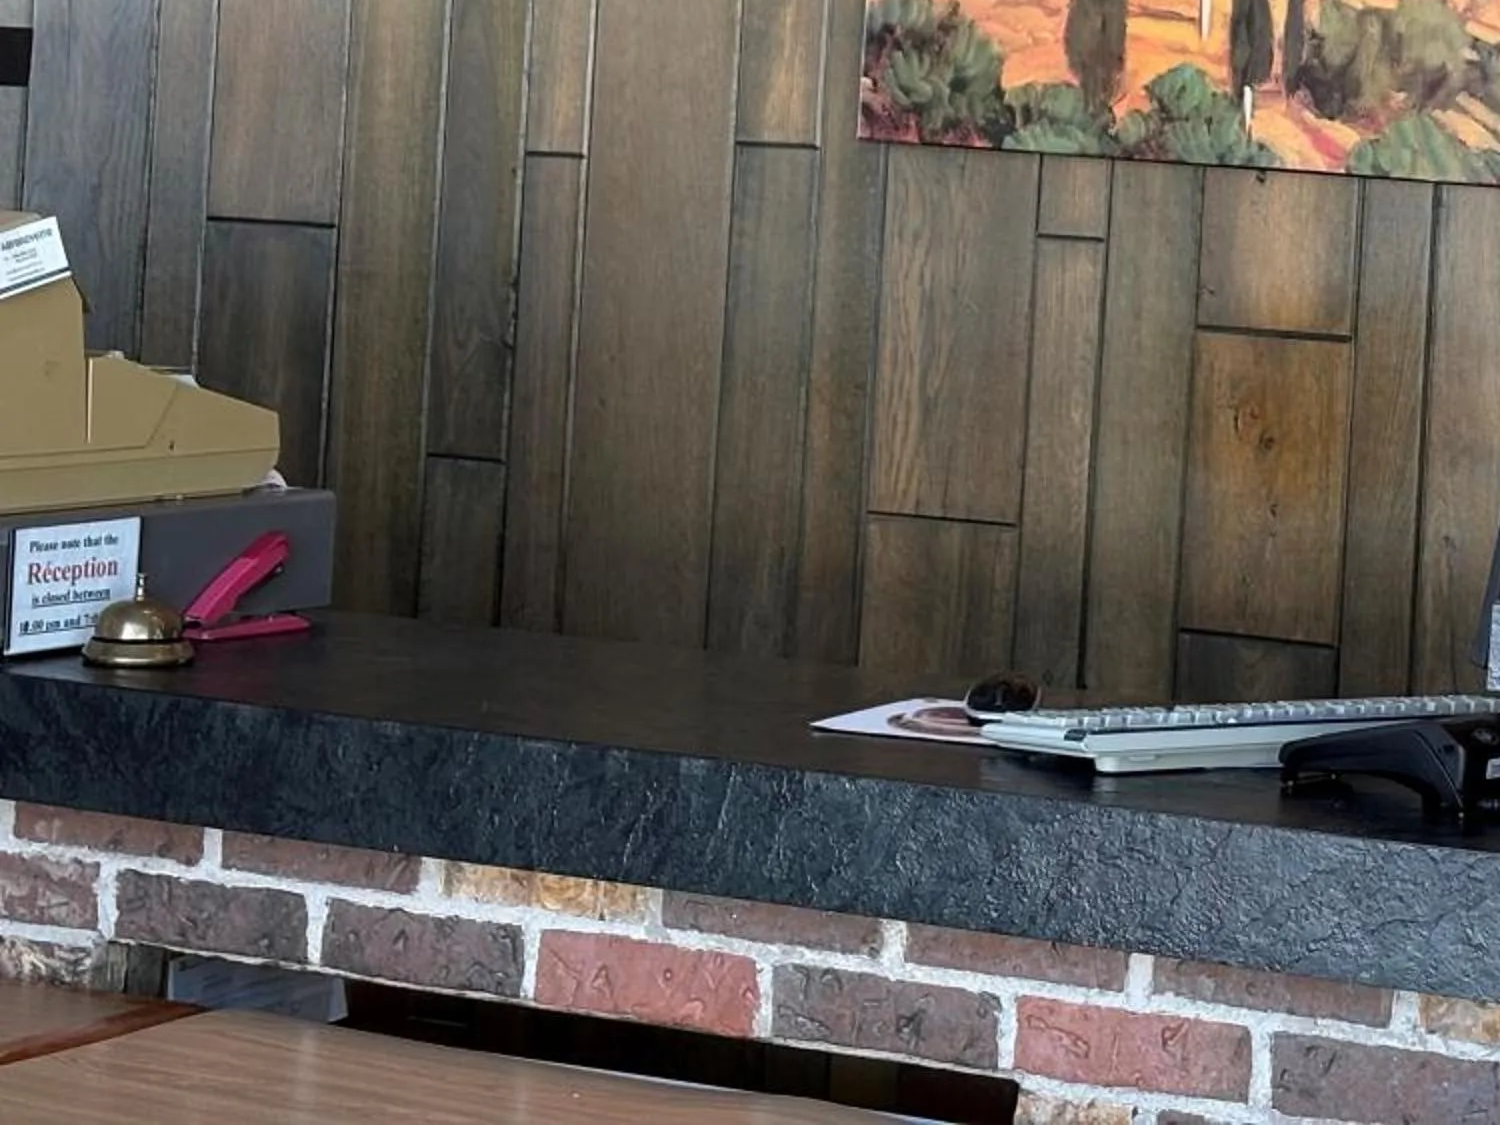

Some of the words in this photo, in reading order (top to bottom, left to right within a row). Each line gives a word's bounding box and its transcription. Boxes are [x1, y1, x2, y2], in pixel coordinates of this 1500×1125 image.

[29, 540, 59, 553] Please
[61, 539, 80, 549] note
[83, 535, 101, 547] that
[103, 533, 119, 545] the
[28, 557, 118, 586] Réception
[63, 615, 80, 627] and
